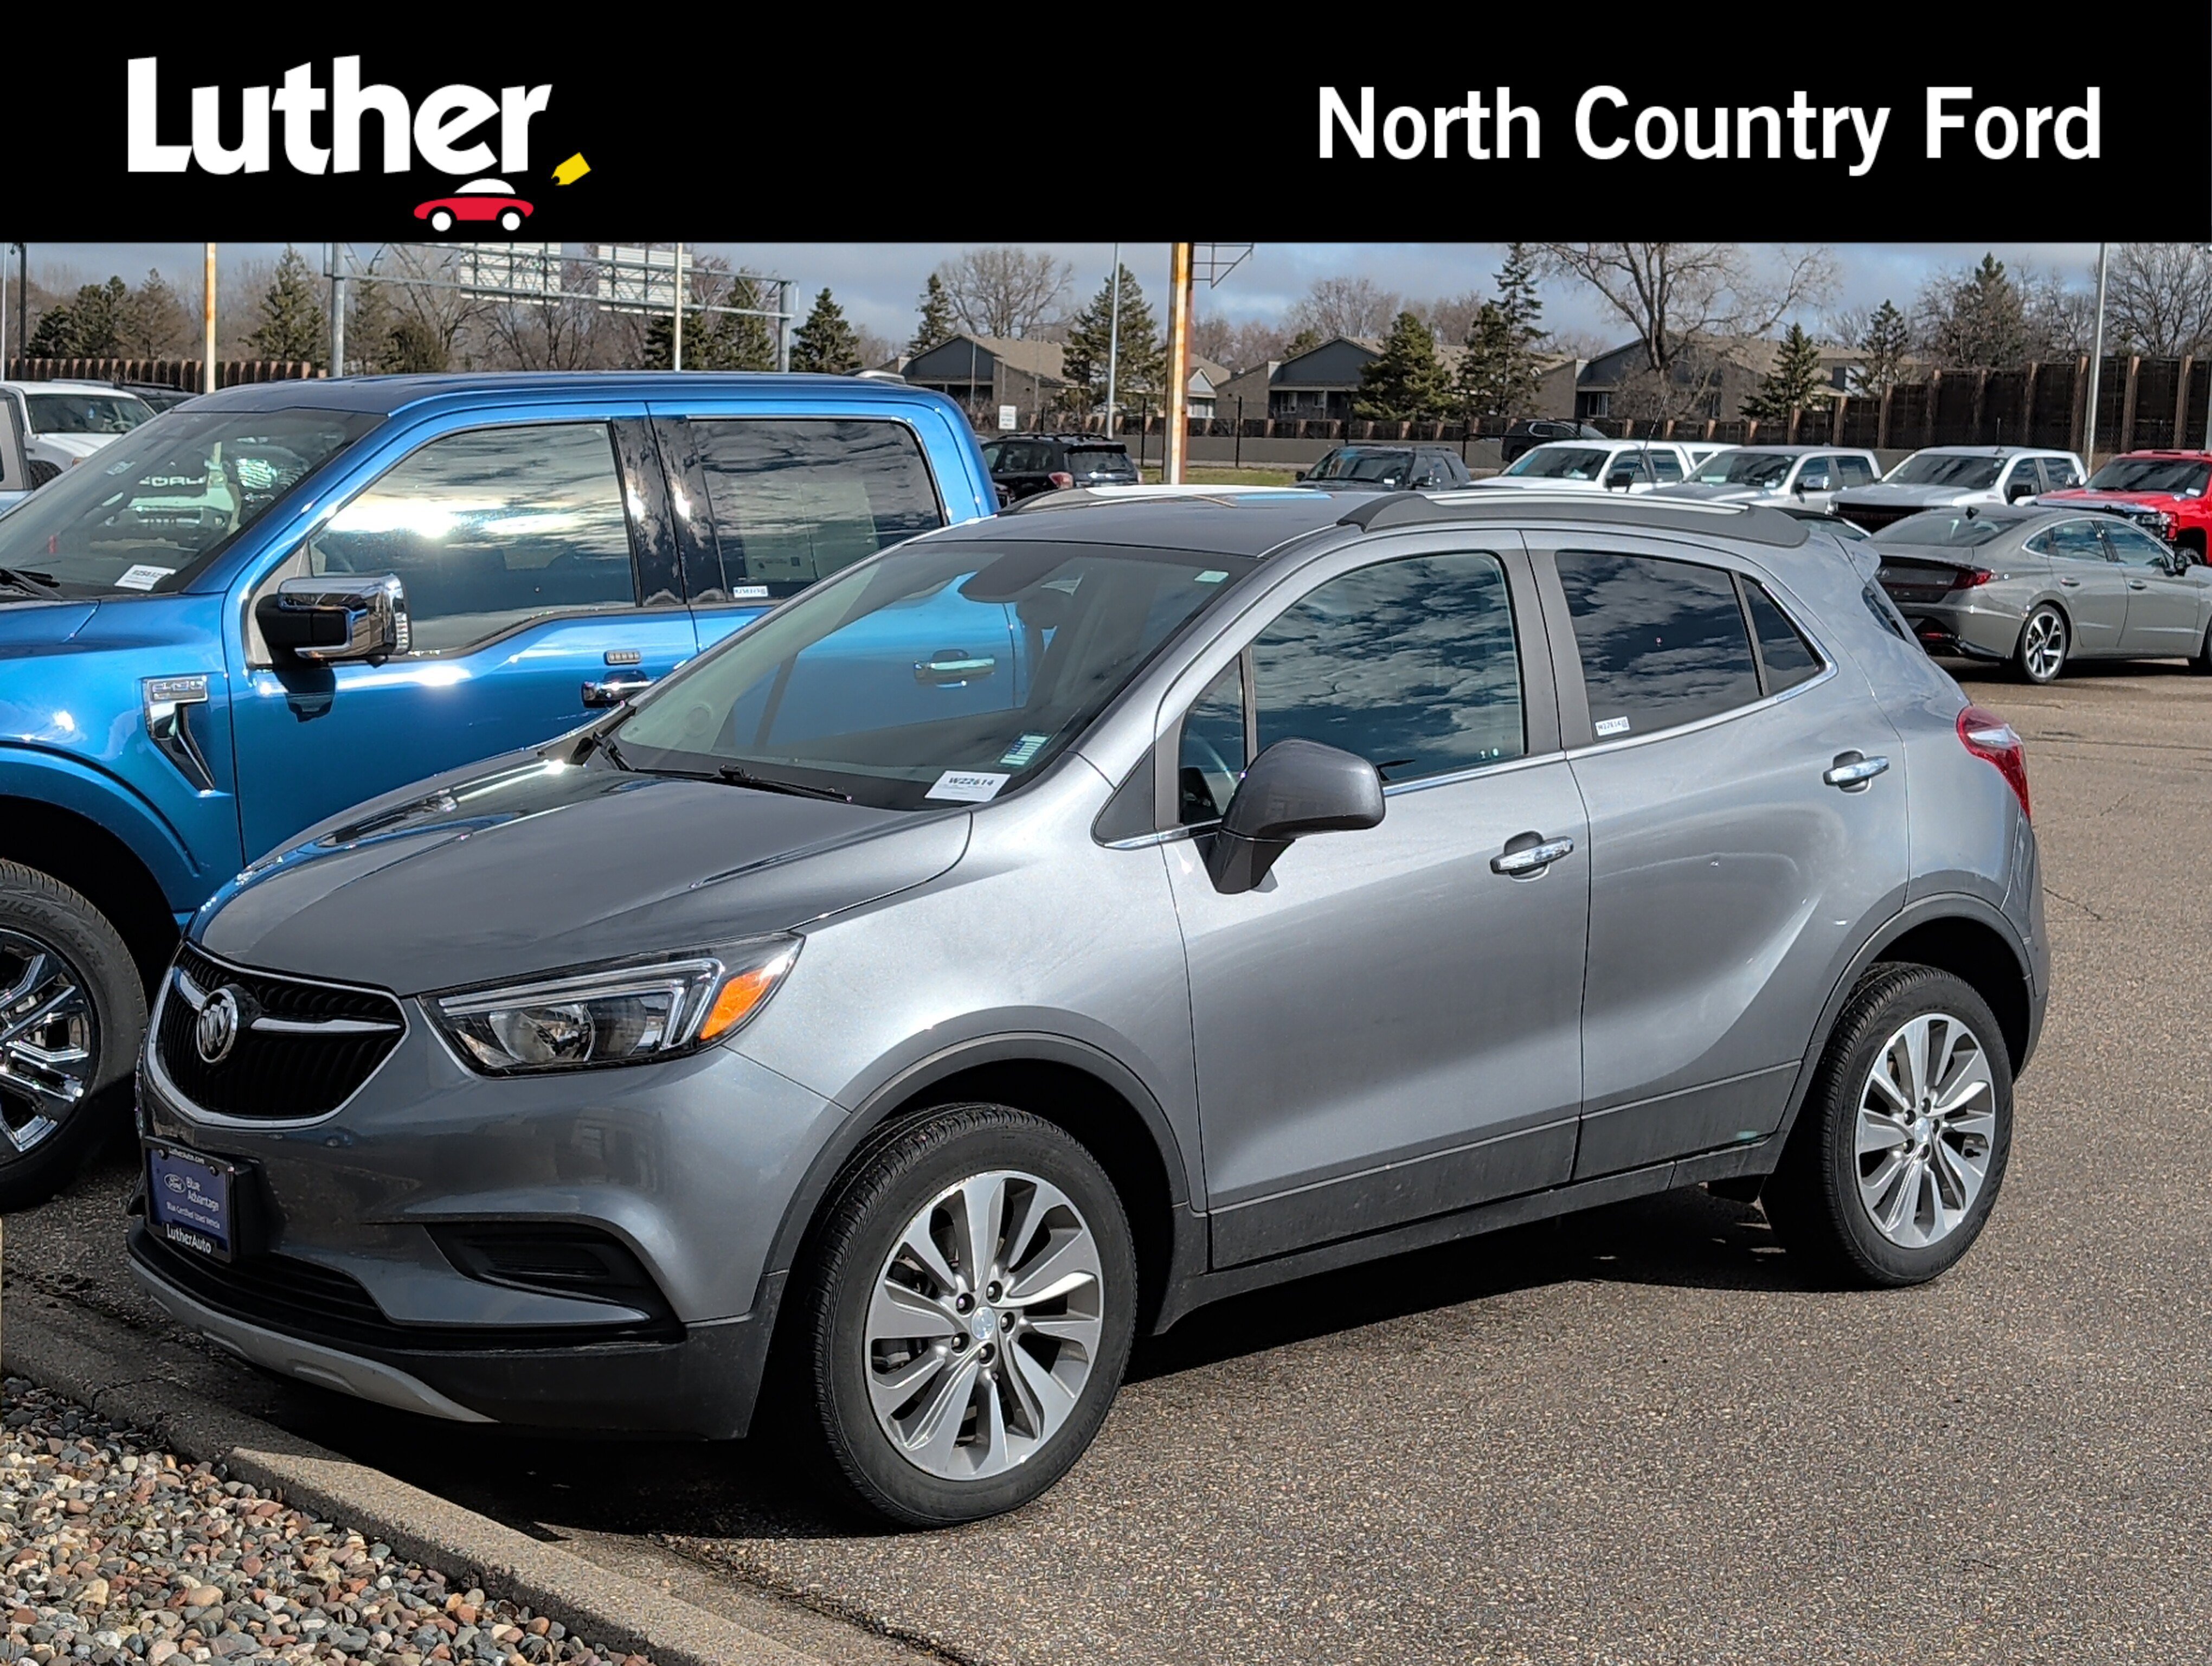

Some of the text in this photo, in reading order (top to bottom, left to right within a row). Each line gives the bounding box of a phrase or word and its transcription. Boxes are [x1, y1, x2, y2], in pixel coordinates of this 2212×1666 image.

[186, 1176, 201, 1191] Blue
[188, 1189, 219, 1212] Advantage
[166, 1223, 211, 1254] LutherAuto
